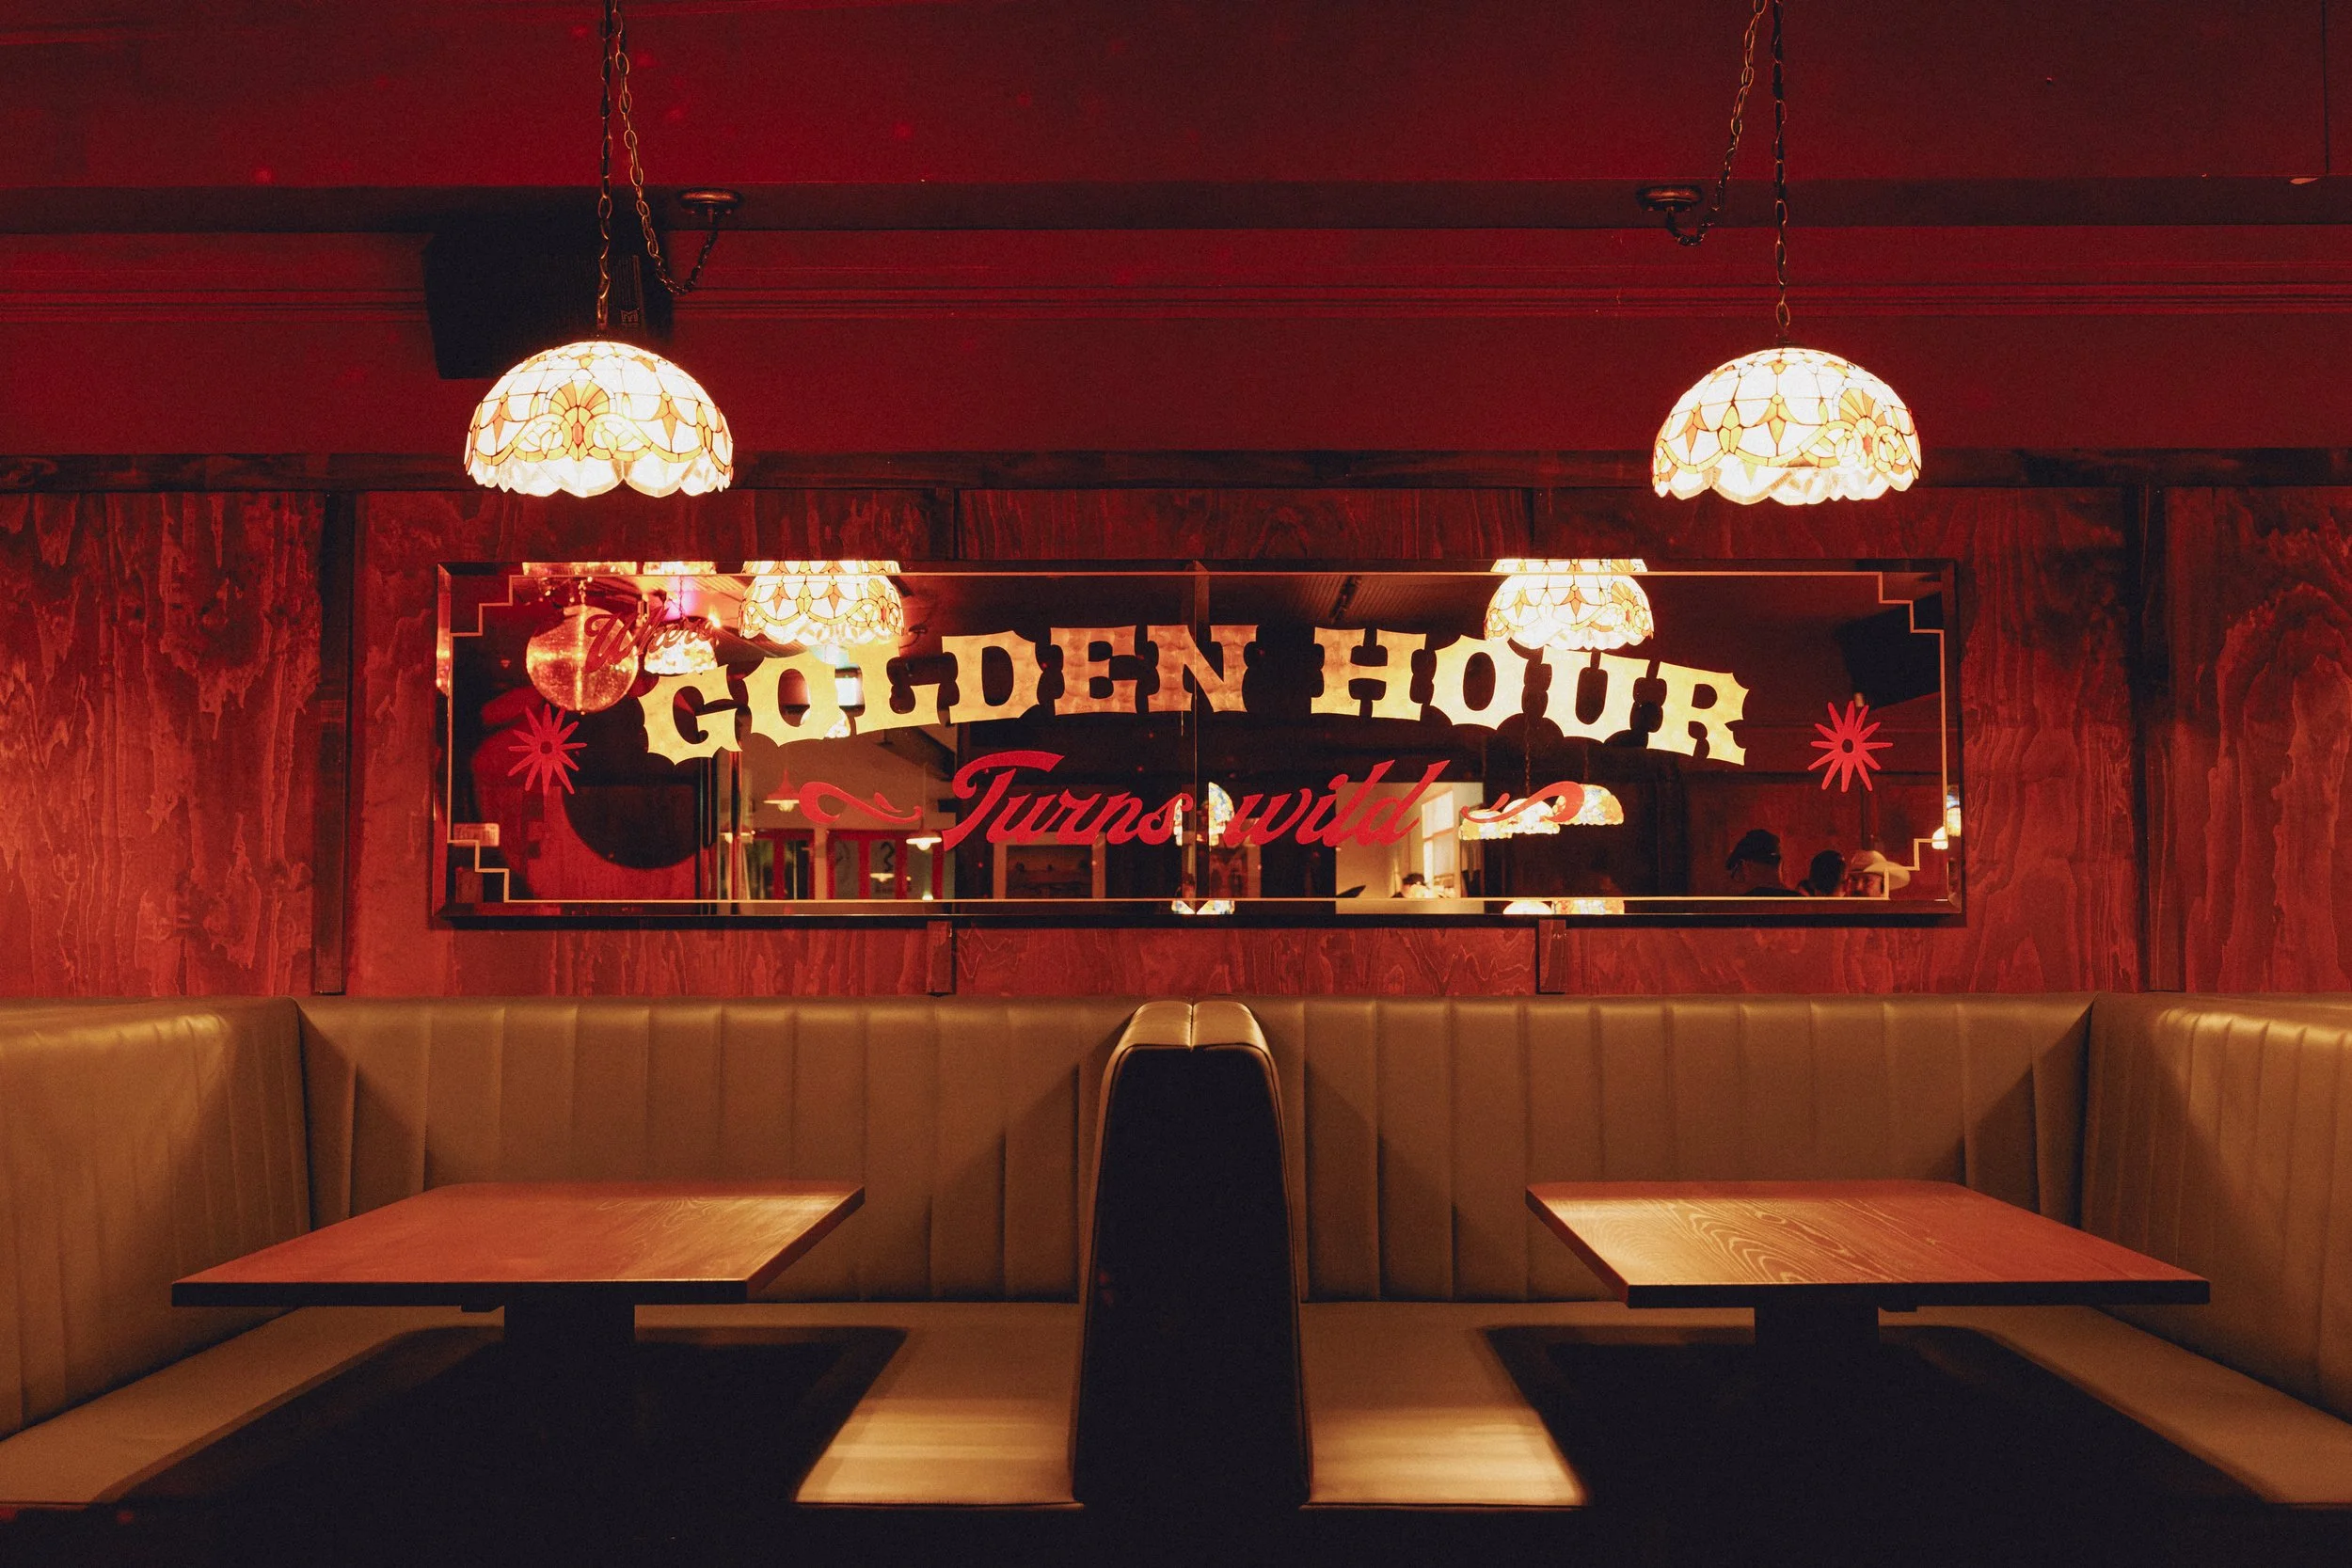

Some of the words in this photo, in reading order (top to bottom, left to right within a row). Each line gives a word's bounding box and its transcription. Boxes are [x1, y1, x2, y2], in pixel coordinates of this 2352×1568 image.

[638, 625, 1257, 765] GOLDEN
[1310, 626, 1749, 767] HOUR
[943, 750, 1194, 850] Turns
[1224, 760, 1451, 847] wild
